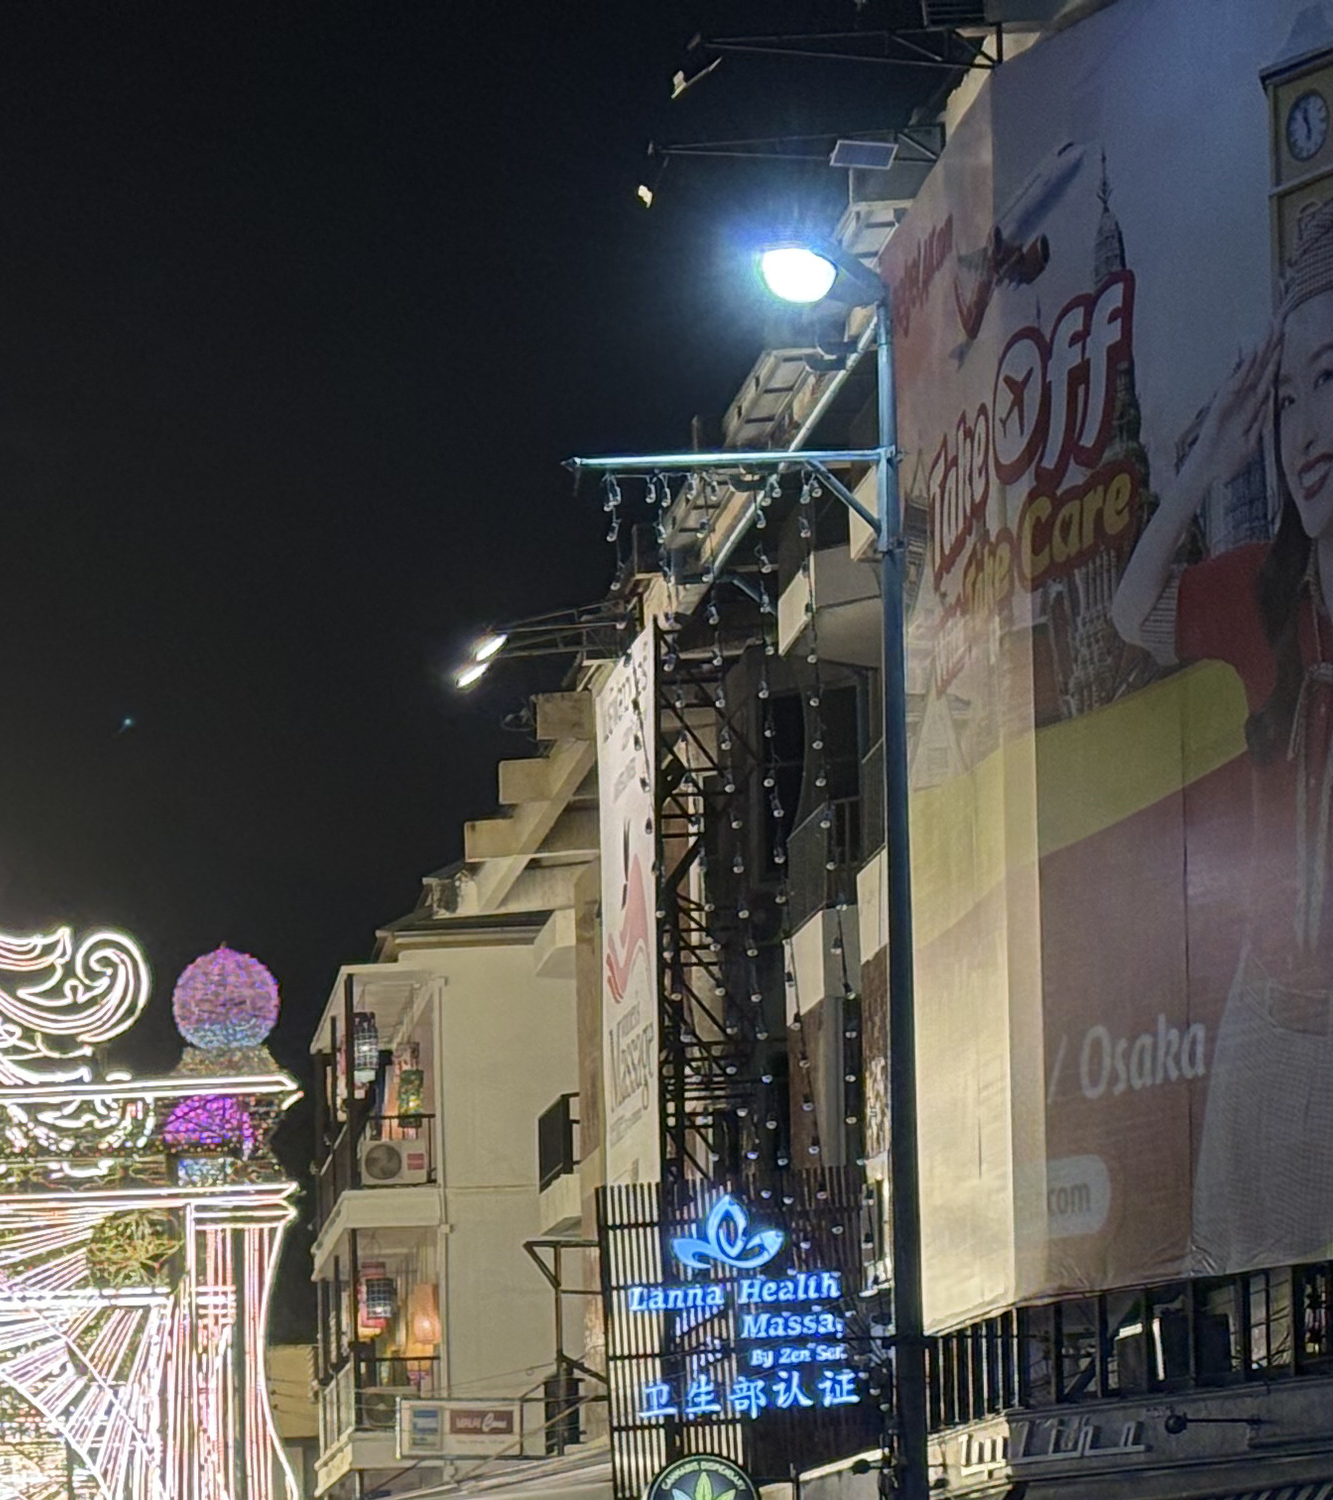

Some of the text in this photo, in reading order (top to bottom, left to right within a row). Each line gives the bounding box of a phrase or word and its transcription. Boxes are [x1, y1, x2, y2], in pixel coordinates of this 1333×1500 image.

[993, 272, 1135, 484] Off
[1021, 470, 1133, 585] Care
[1079, 1014, 1207, 1100] Osaka
[630, 1271, 842, 1312] Lanna Health
[740, 1312, 846, 1340] Massa
[750, 1349, 774, 1368] By
[778, 1347, 812, 1364] Zen
[638, 1369, 861, 1420] 卫生部认证
